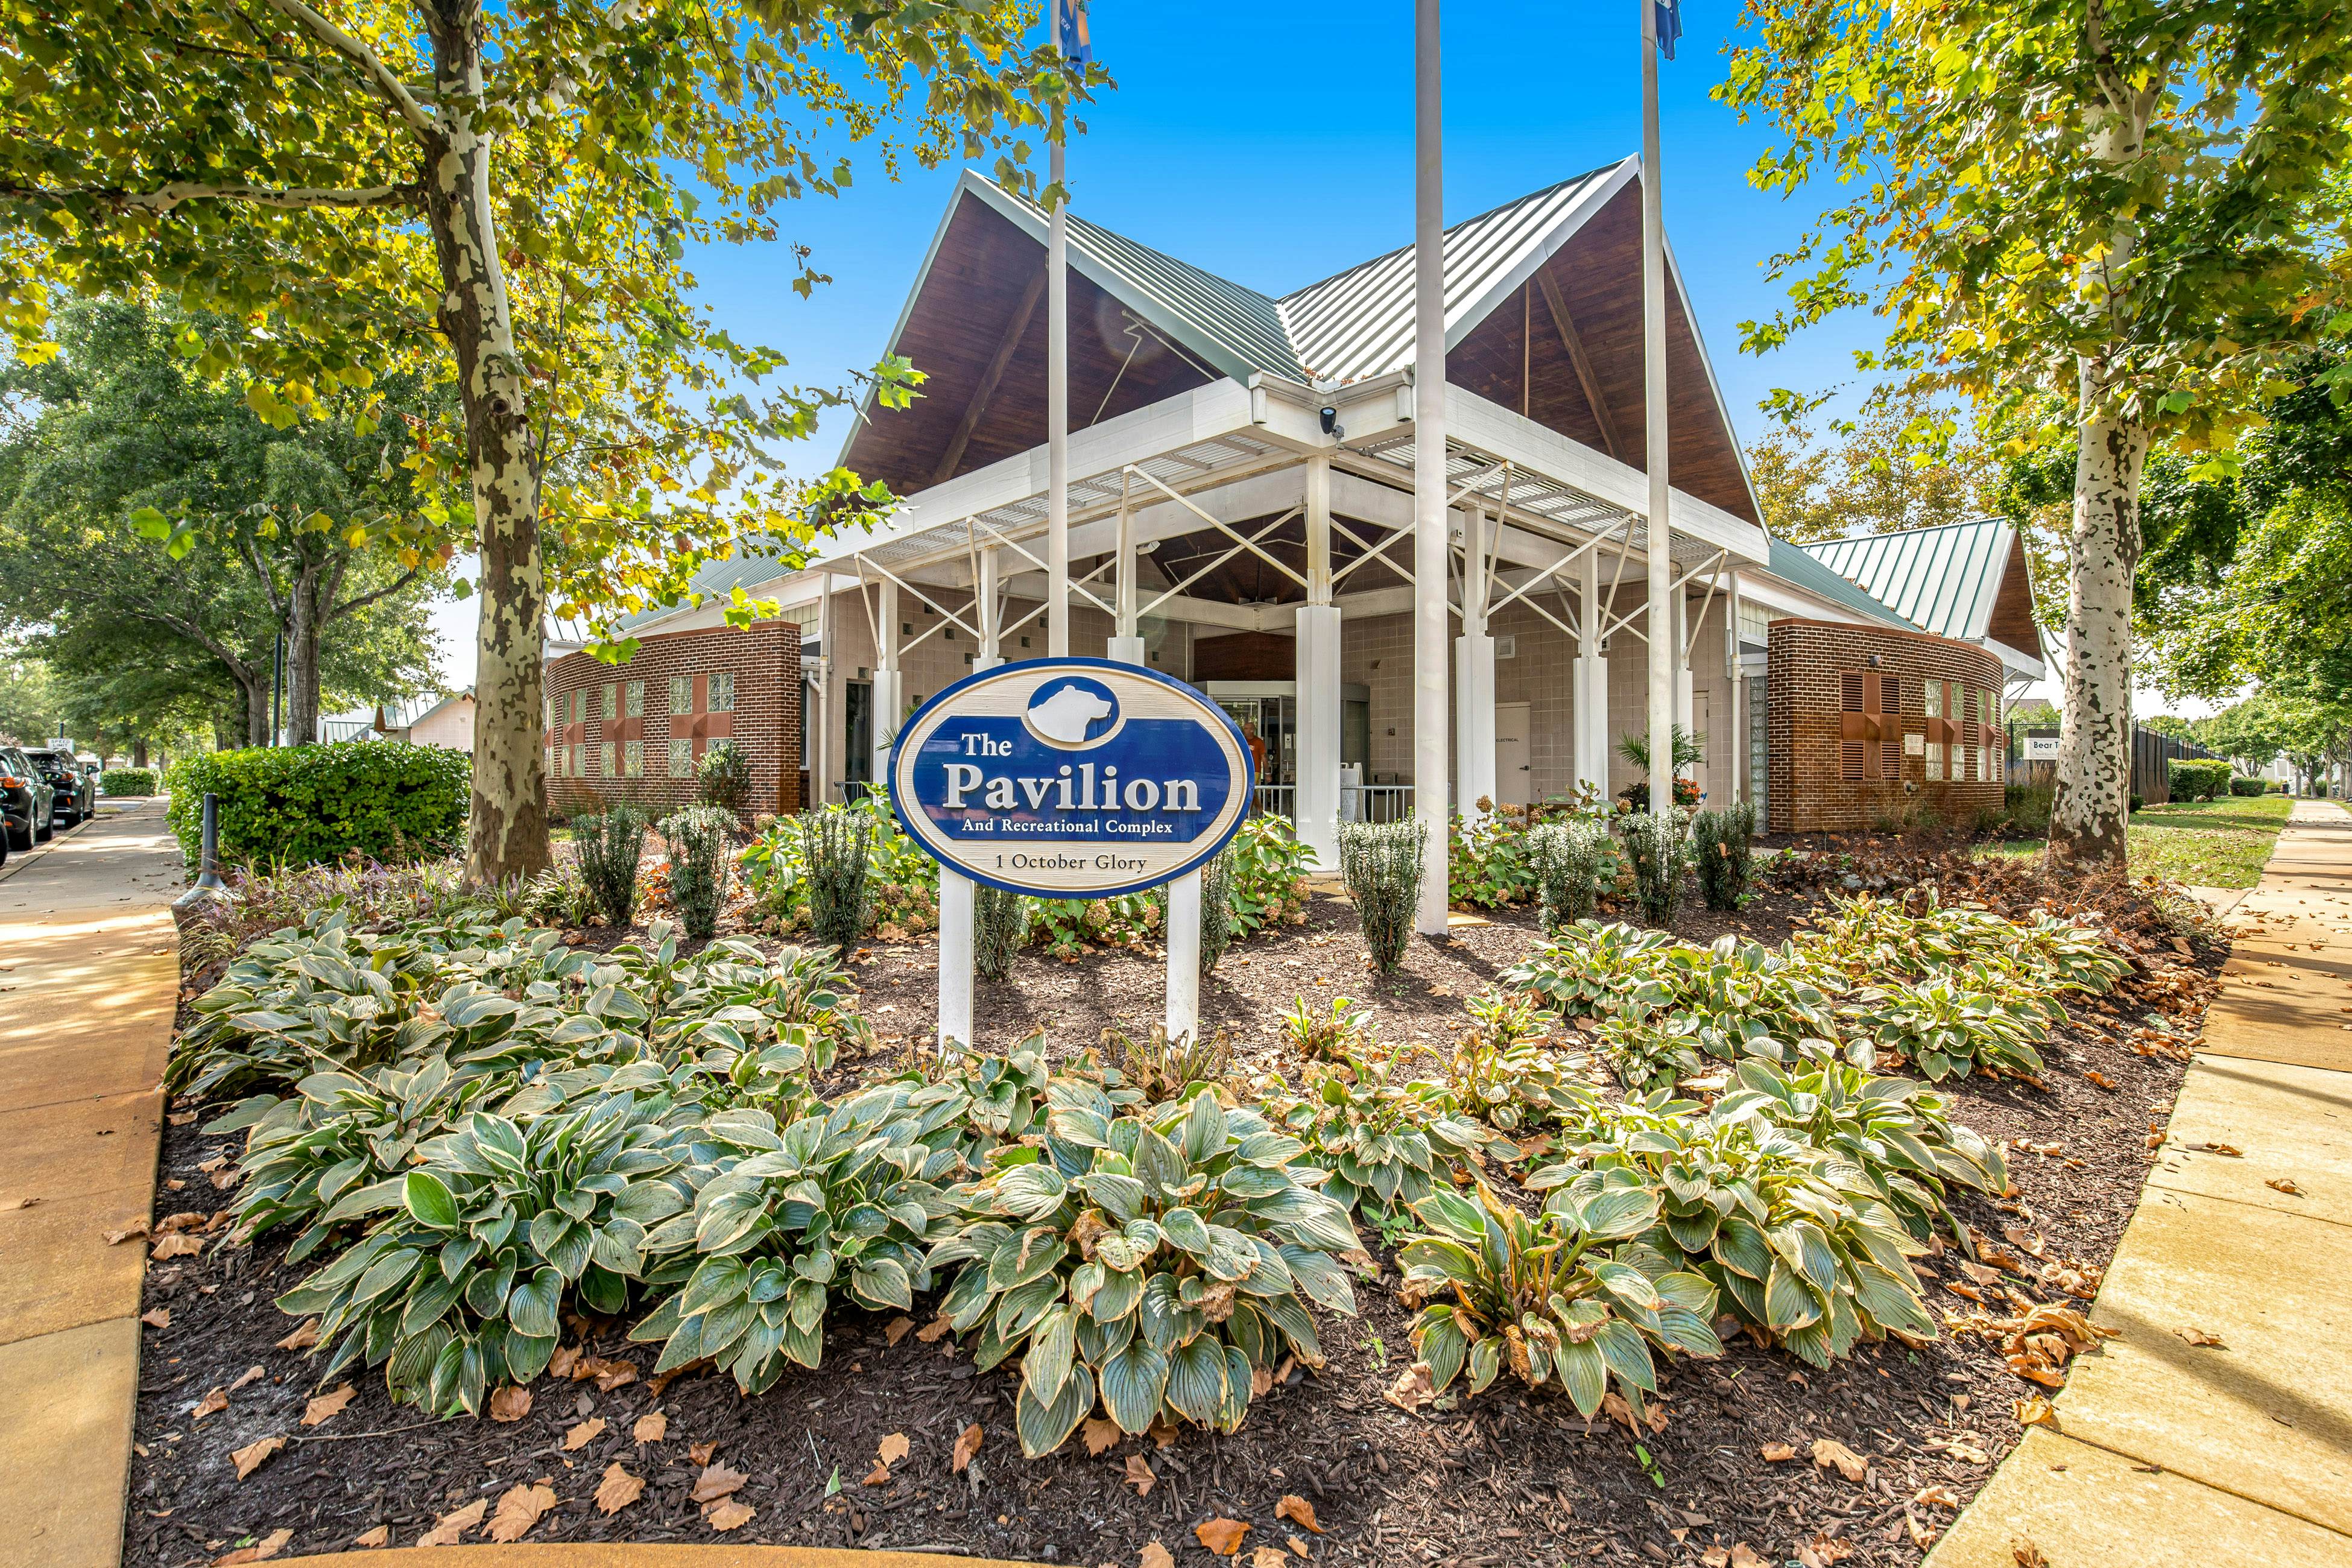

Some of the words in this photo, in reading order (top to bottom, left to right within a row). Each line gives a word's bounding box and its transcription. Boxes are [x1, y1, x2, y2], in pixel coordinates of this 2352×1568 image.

[961, 733, 1013, 757] The
[942, 762, 1202, 811] Pavilion
[961, 818, 994, 832] And
[1001, 818, 1099, 833] Recreational
[1105, 819, 1174, 837] Complex
[996, 855, 1002, 868] 1
[1012, 853, 1086, 869] October
[1095, 853, 1147, 873] Glory
